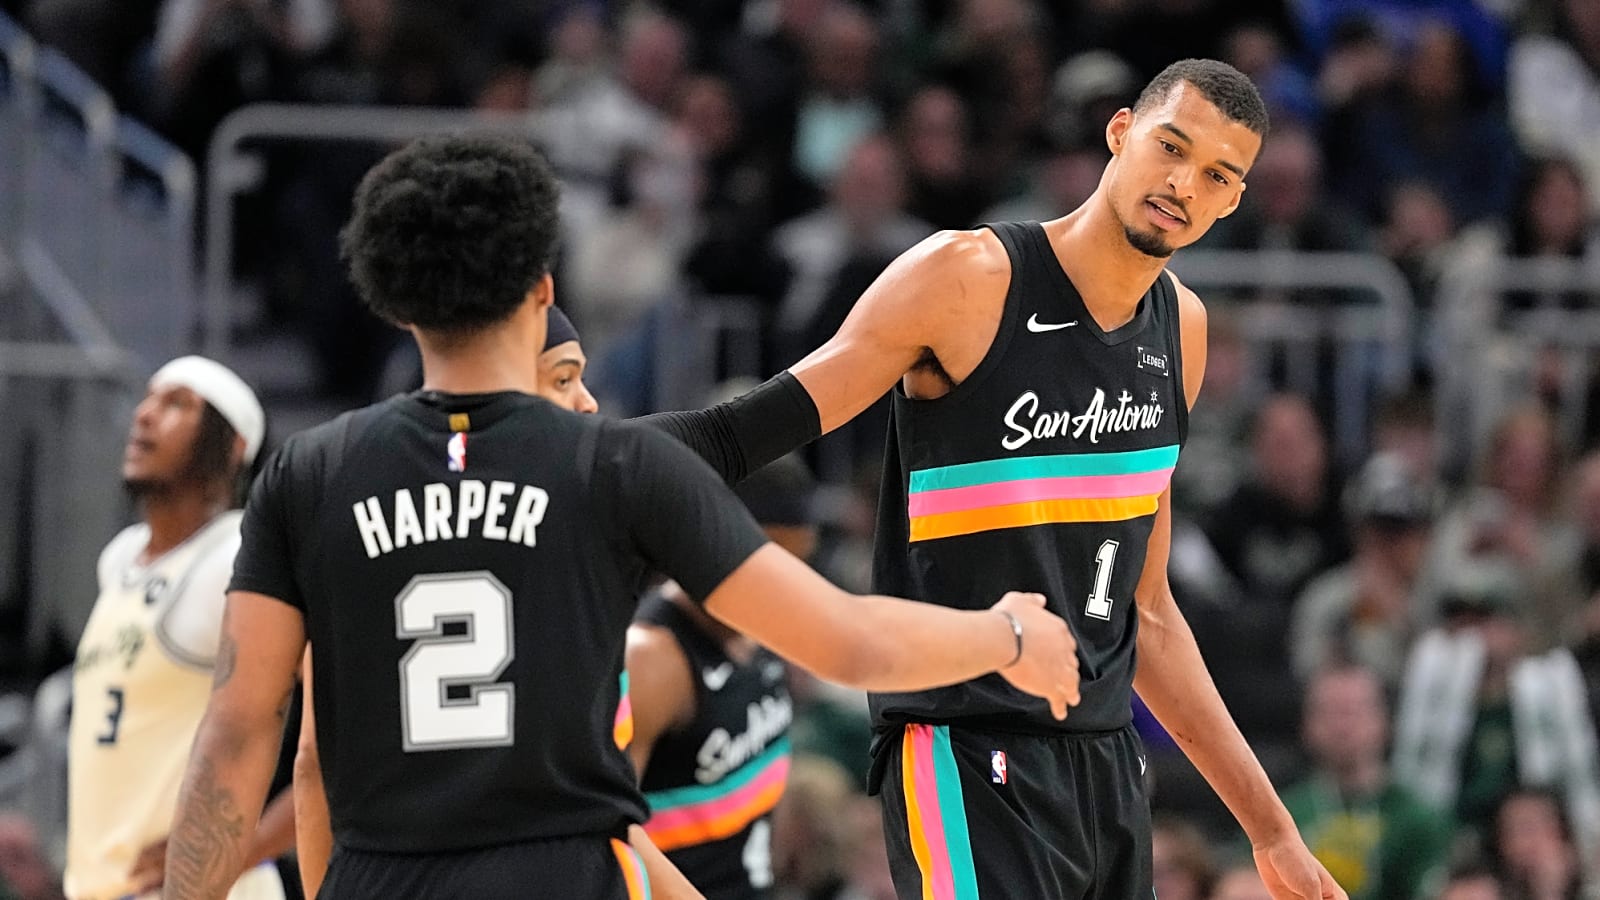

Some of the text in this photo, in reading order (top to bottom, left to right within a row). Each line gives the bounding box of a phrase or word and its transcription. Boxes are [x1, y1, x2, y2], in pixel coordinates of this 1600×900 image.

[1142, 353, 1166, 370] LEDGER
[1001, 386, 1164, 451] San Antonio
[352, 480, 549, 559] HARPER
[1084, 539, 1120, 621] 1
[394, 570, 515, 752] 2
[97, 687, 125, 746] 3
